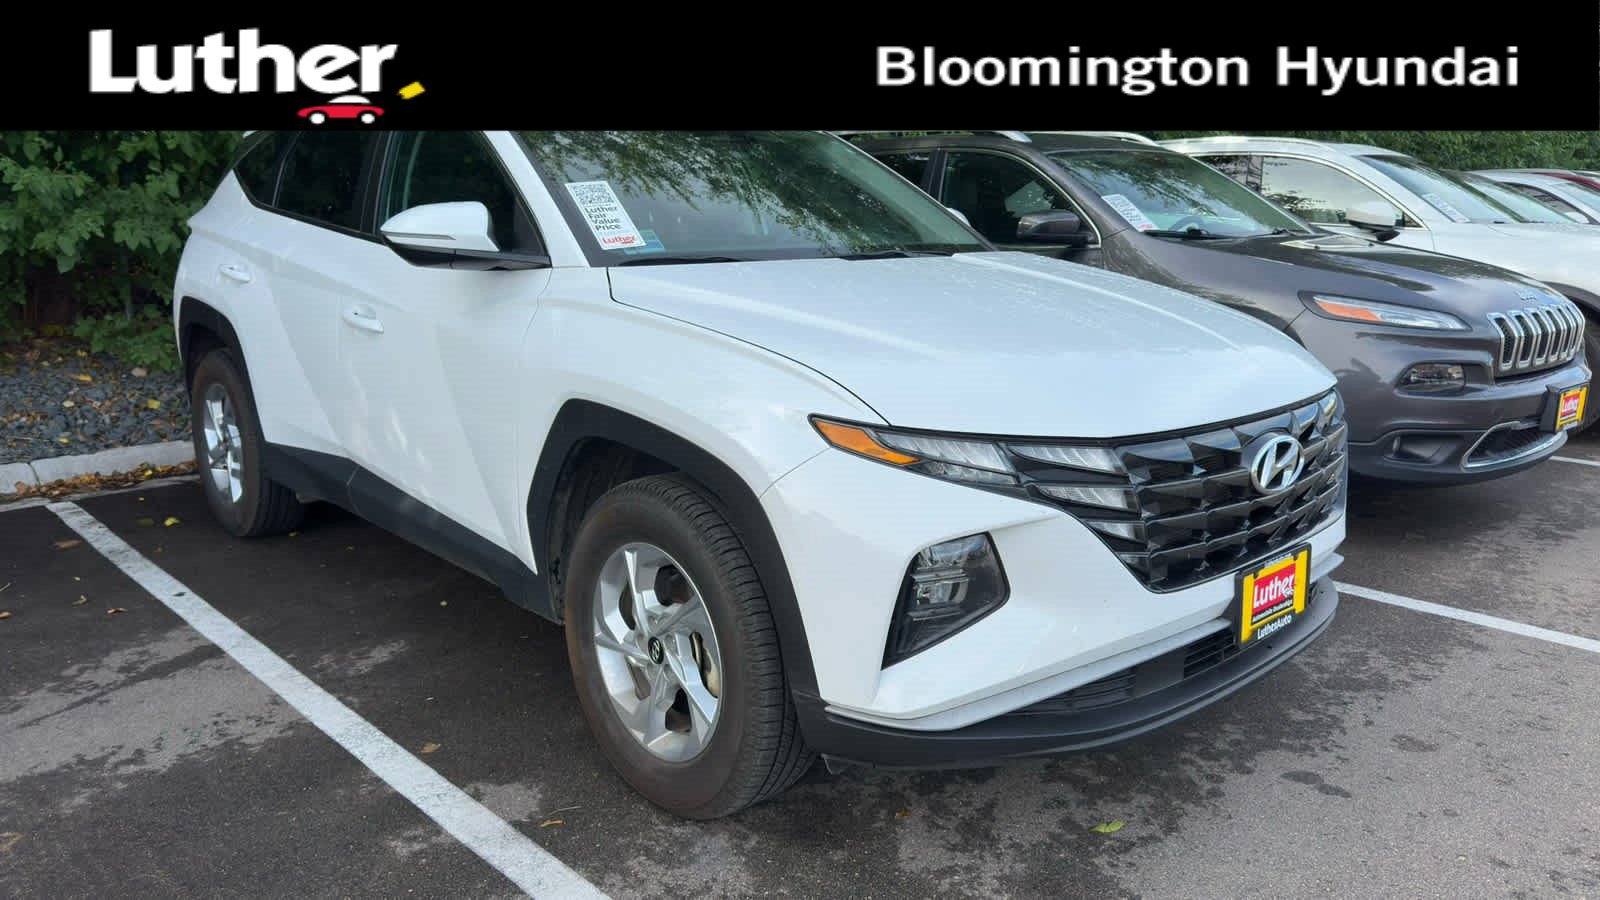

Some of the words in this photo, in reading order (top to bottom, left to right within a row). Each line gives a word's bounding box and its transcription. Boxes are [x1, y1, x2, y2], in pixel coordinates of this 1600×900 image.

[584, 206, 618, 214] Luther
[595, 223, 621, 231] Price
[602, 235, 636, 244] Luther
[1252, 573, 1295, 609] Luther
